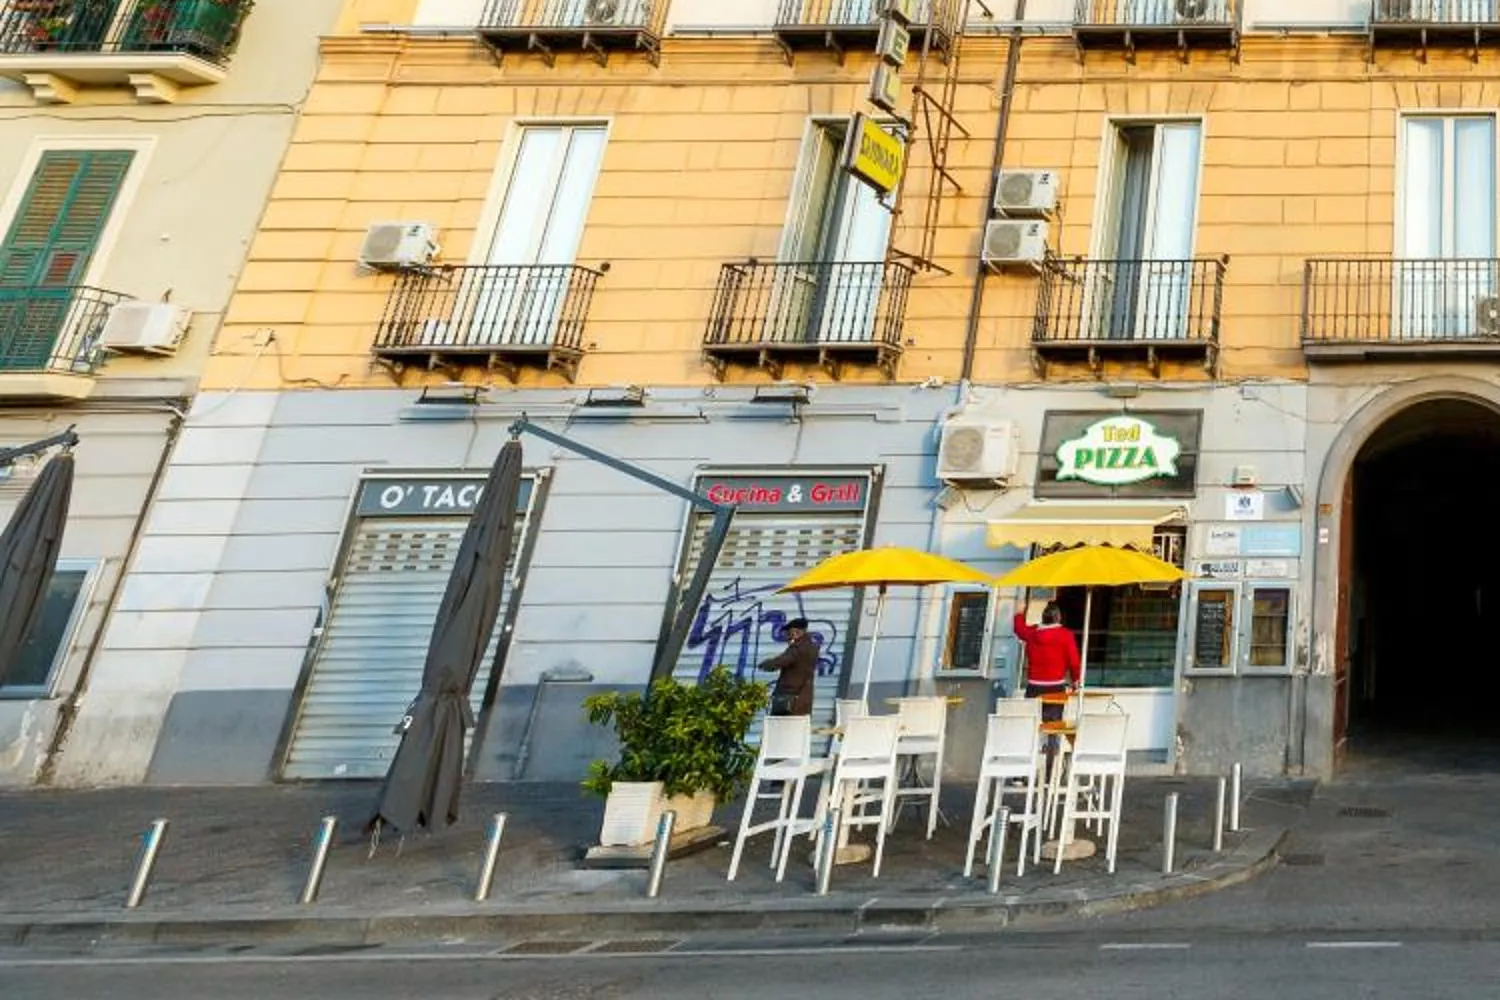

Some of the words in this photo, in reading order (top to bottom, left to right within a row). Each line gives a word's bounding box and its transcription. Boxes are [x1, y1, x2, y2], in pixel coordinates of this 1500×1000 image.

[1074, 446, 1158, 469] PIZZA
[380, 485, 414, 508] O'
[707, 483, 782, 505] Cucina
[786, 484, 803, 503] &
[810, 482, 861, 504] Grill
